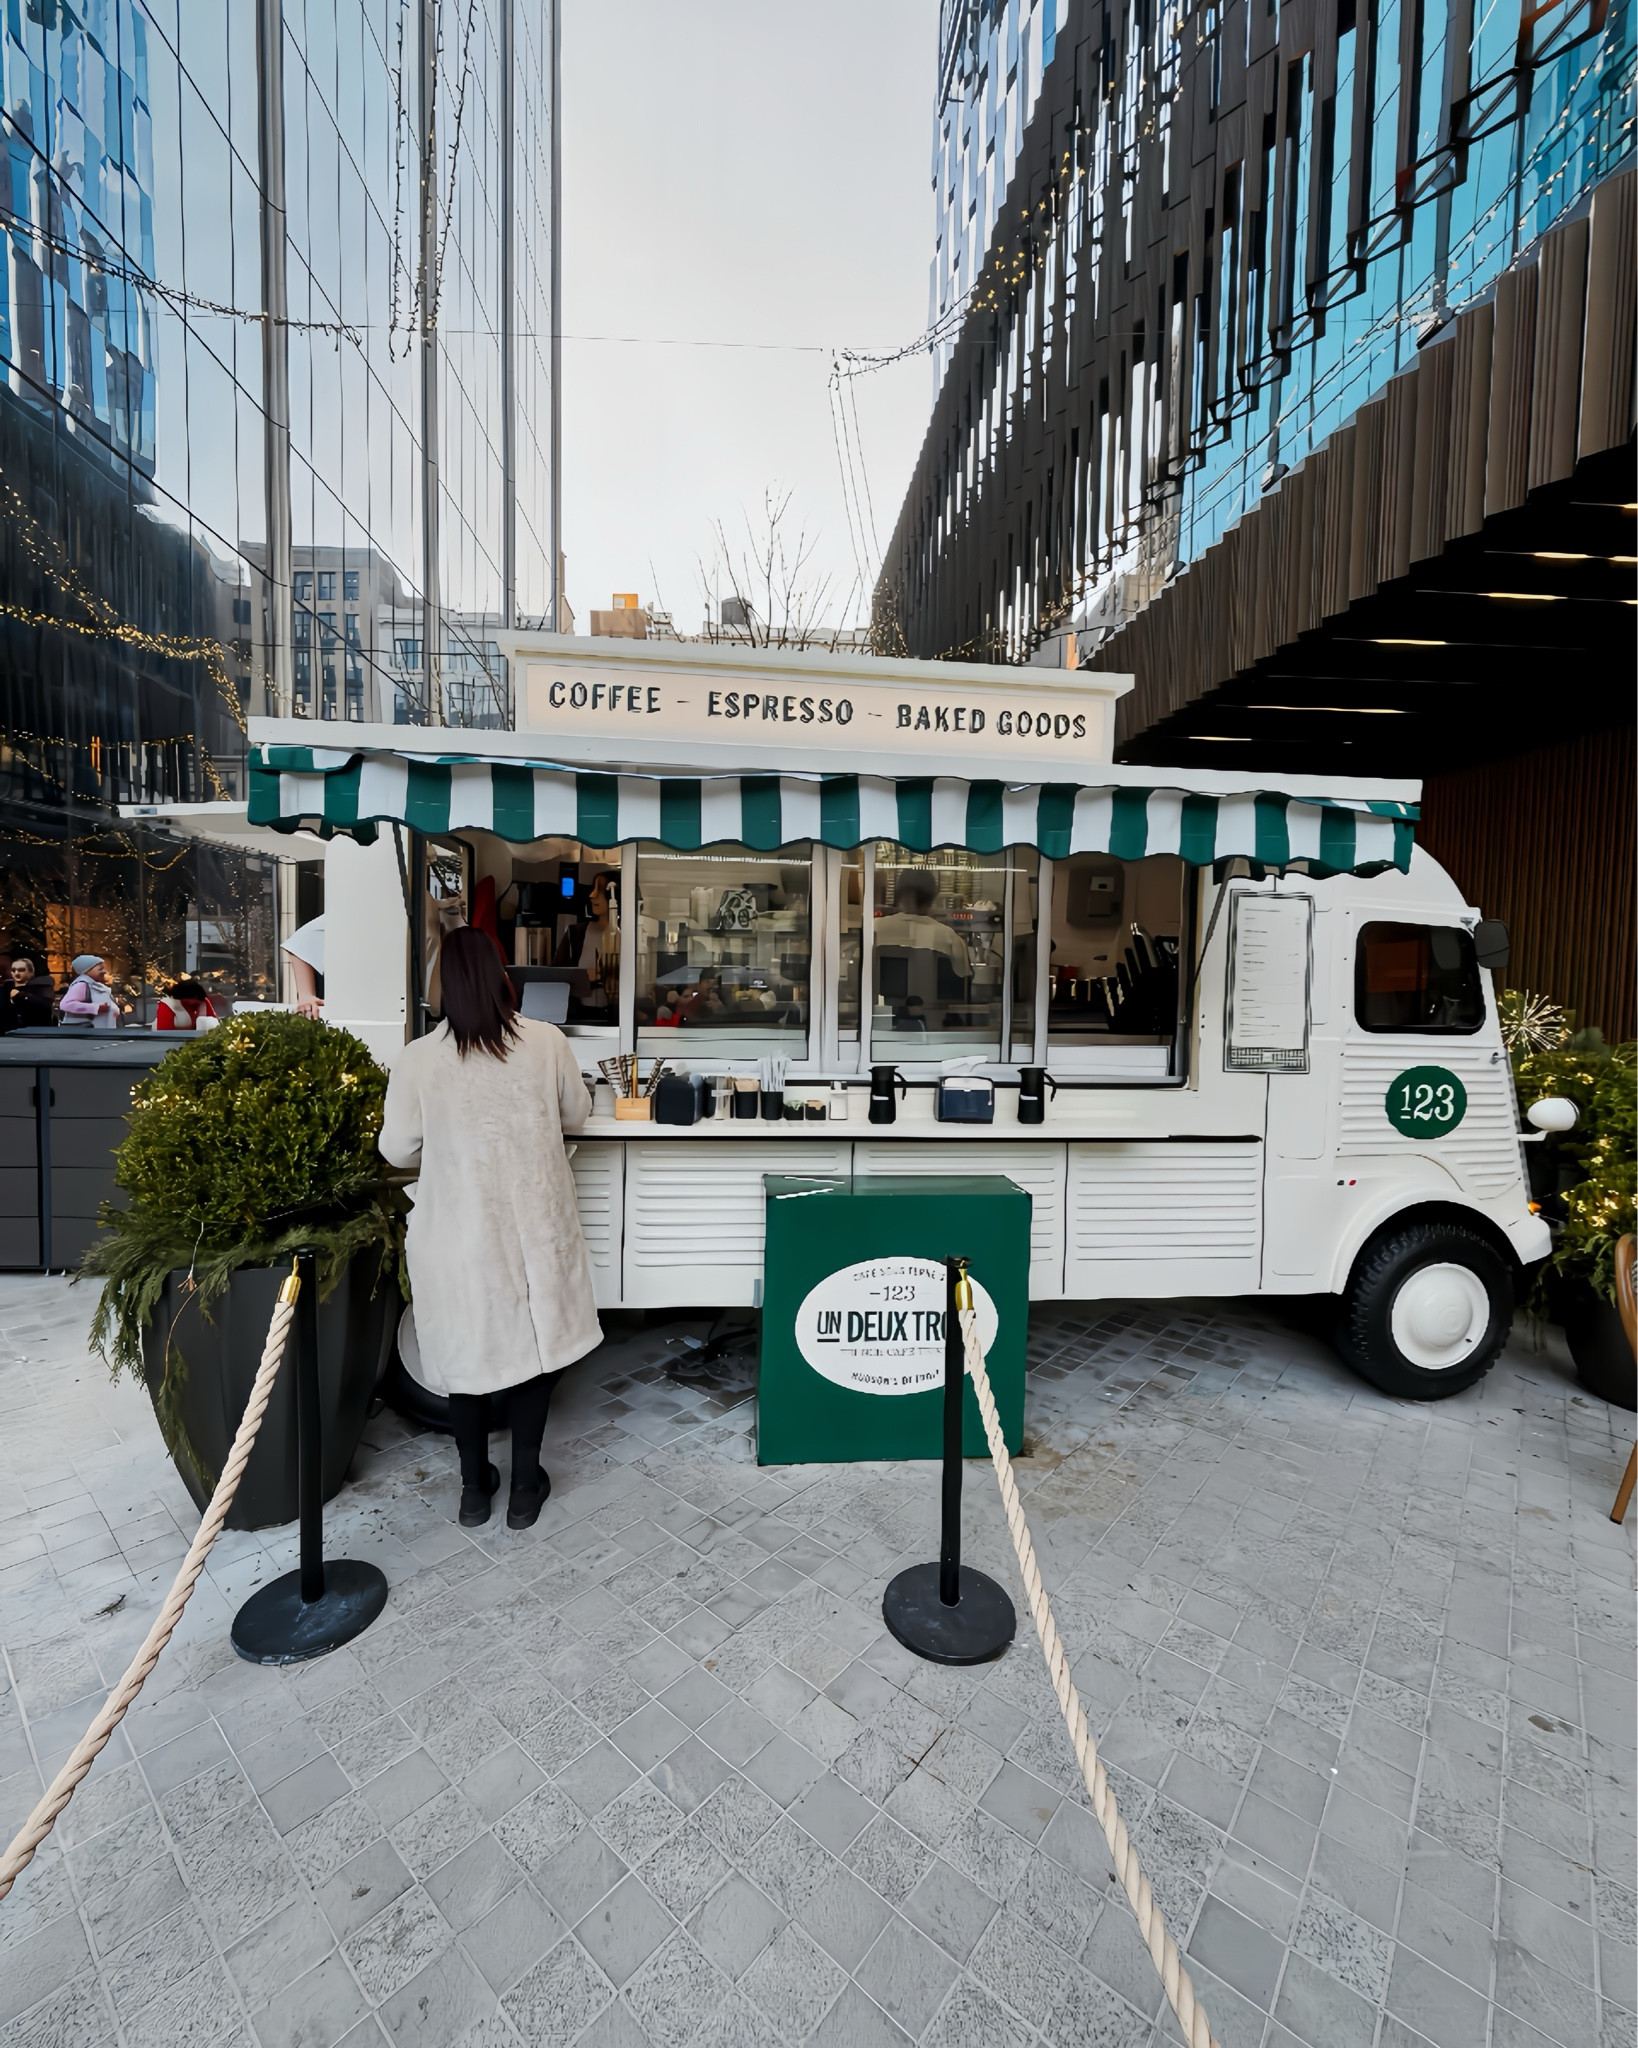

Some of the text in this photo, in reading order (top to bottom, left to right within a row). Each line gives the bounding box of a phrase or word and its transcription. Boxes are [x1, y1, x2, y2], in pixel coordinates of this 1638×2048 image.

[549, 681, 1087, 739] COFFEE ESPRESSO BAKED GOODS
[1401, 1084, 1455, 1121] 123
[817, 1310, 842, 1335] UN
[847, 1310, 909, 1343] DEUX
